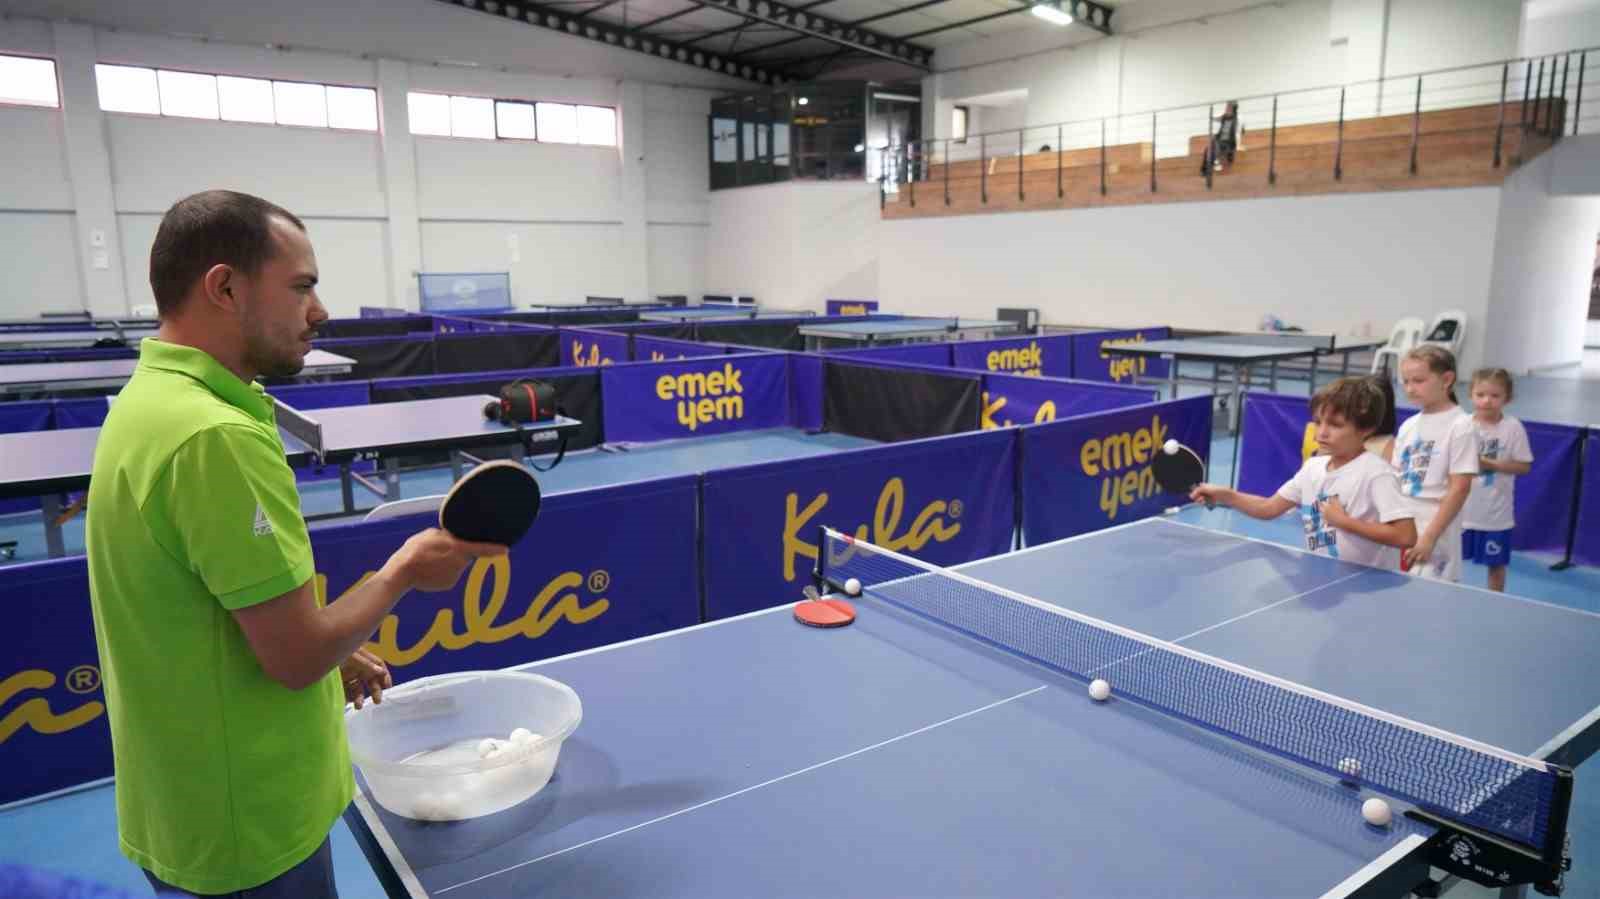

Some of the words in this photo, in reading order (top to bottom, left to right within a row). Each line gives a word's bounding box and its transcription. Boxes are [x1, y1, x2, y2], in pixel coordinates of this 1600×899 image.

[987, 341, 1042, 371] emek
[656, 363, 744, 400] emek
[677, 395, 744, 431] yem
[1080, 415, 1168, 476] emek
